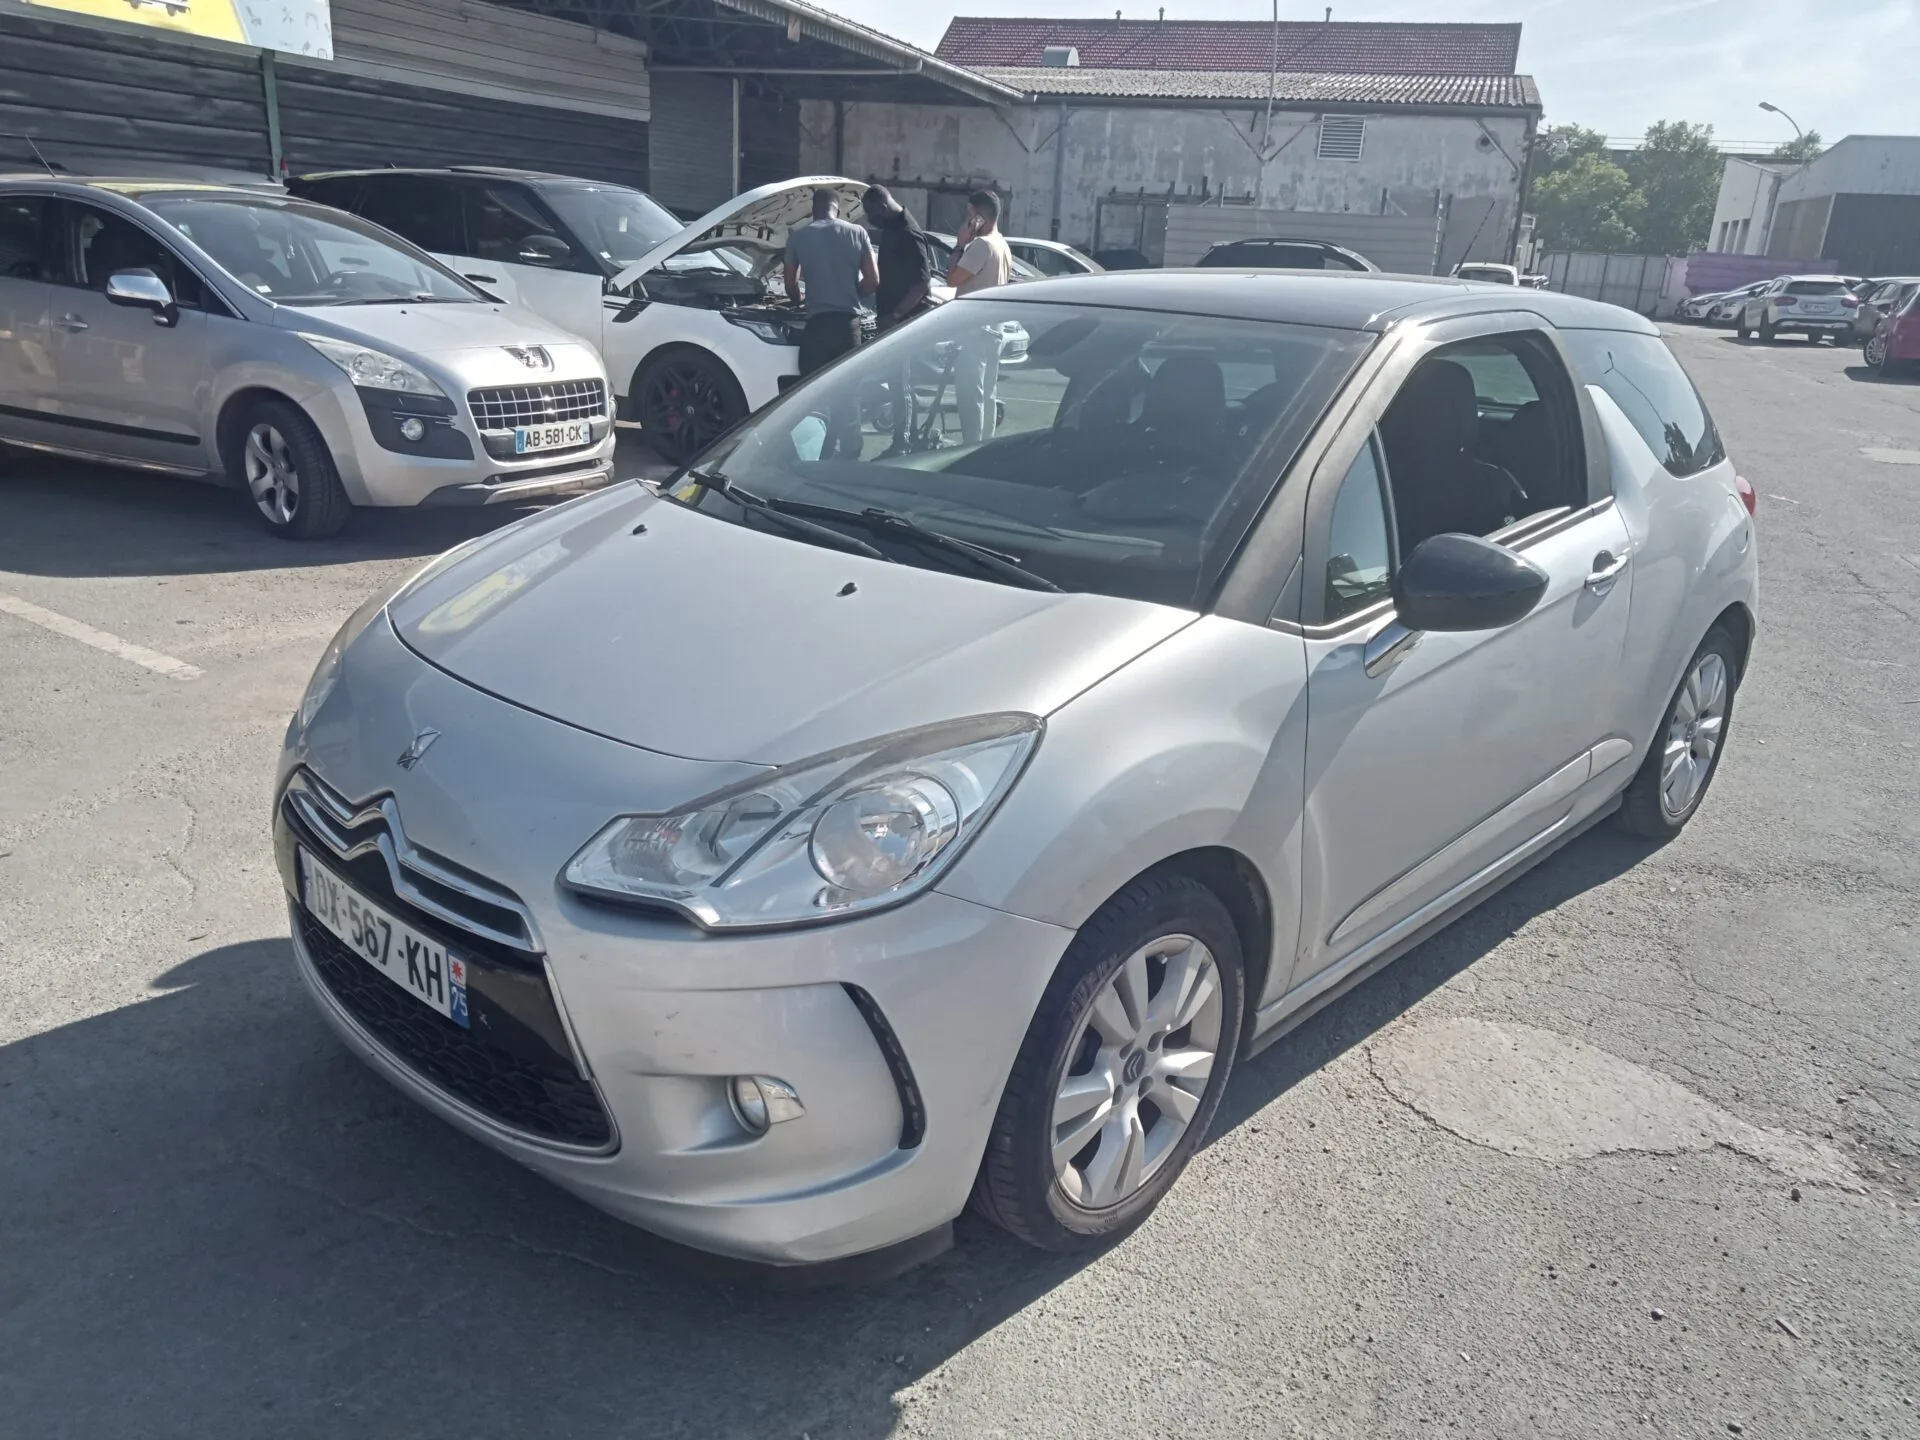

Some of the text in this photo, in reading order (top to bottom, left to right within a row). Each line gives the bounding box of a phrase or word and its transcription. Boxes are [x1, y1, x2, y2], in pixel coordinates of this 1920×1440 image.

[525, 424, 582, 448] AB-581-CK
[314, 867, 444, 1005] DX-567-KH
[451, 986, 468, 1017] 75
